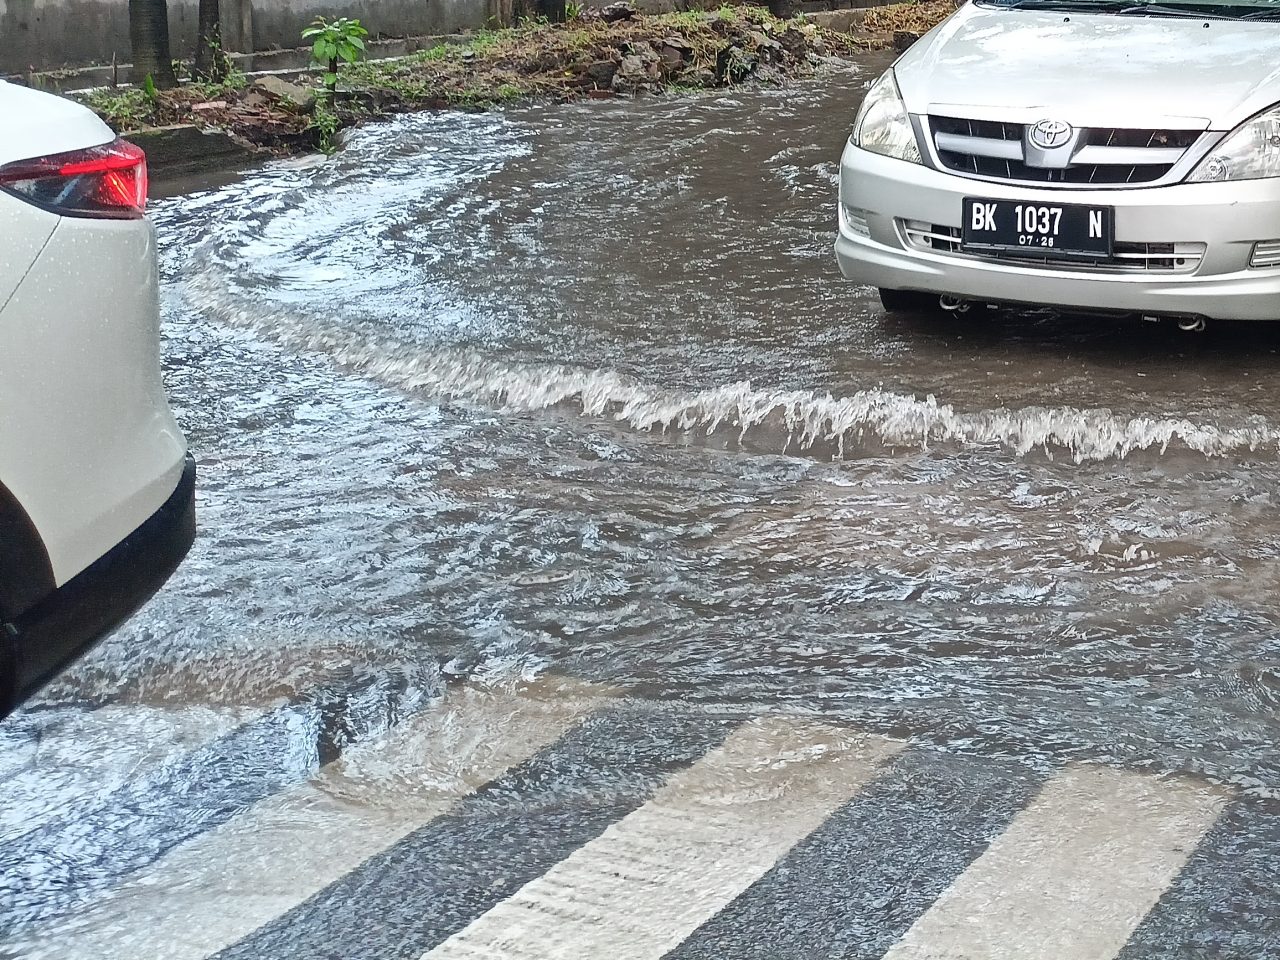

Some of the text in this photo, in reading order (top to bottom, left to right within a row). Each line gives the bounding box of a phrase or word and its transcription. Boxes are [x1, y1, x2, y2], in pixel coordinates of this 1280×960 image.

[971, 202, 1103, 238] BK 1037 N
